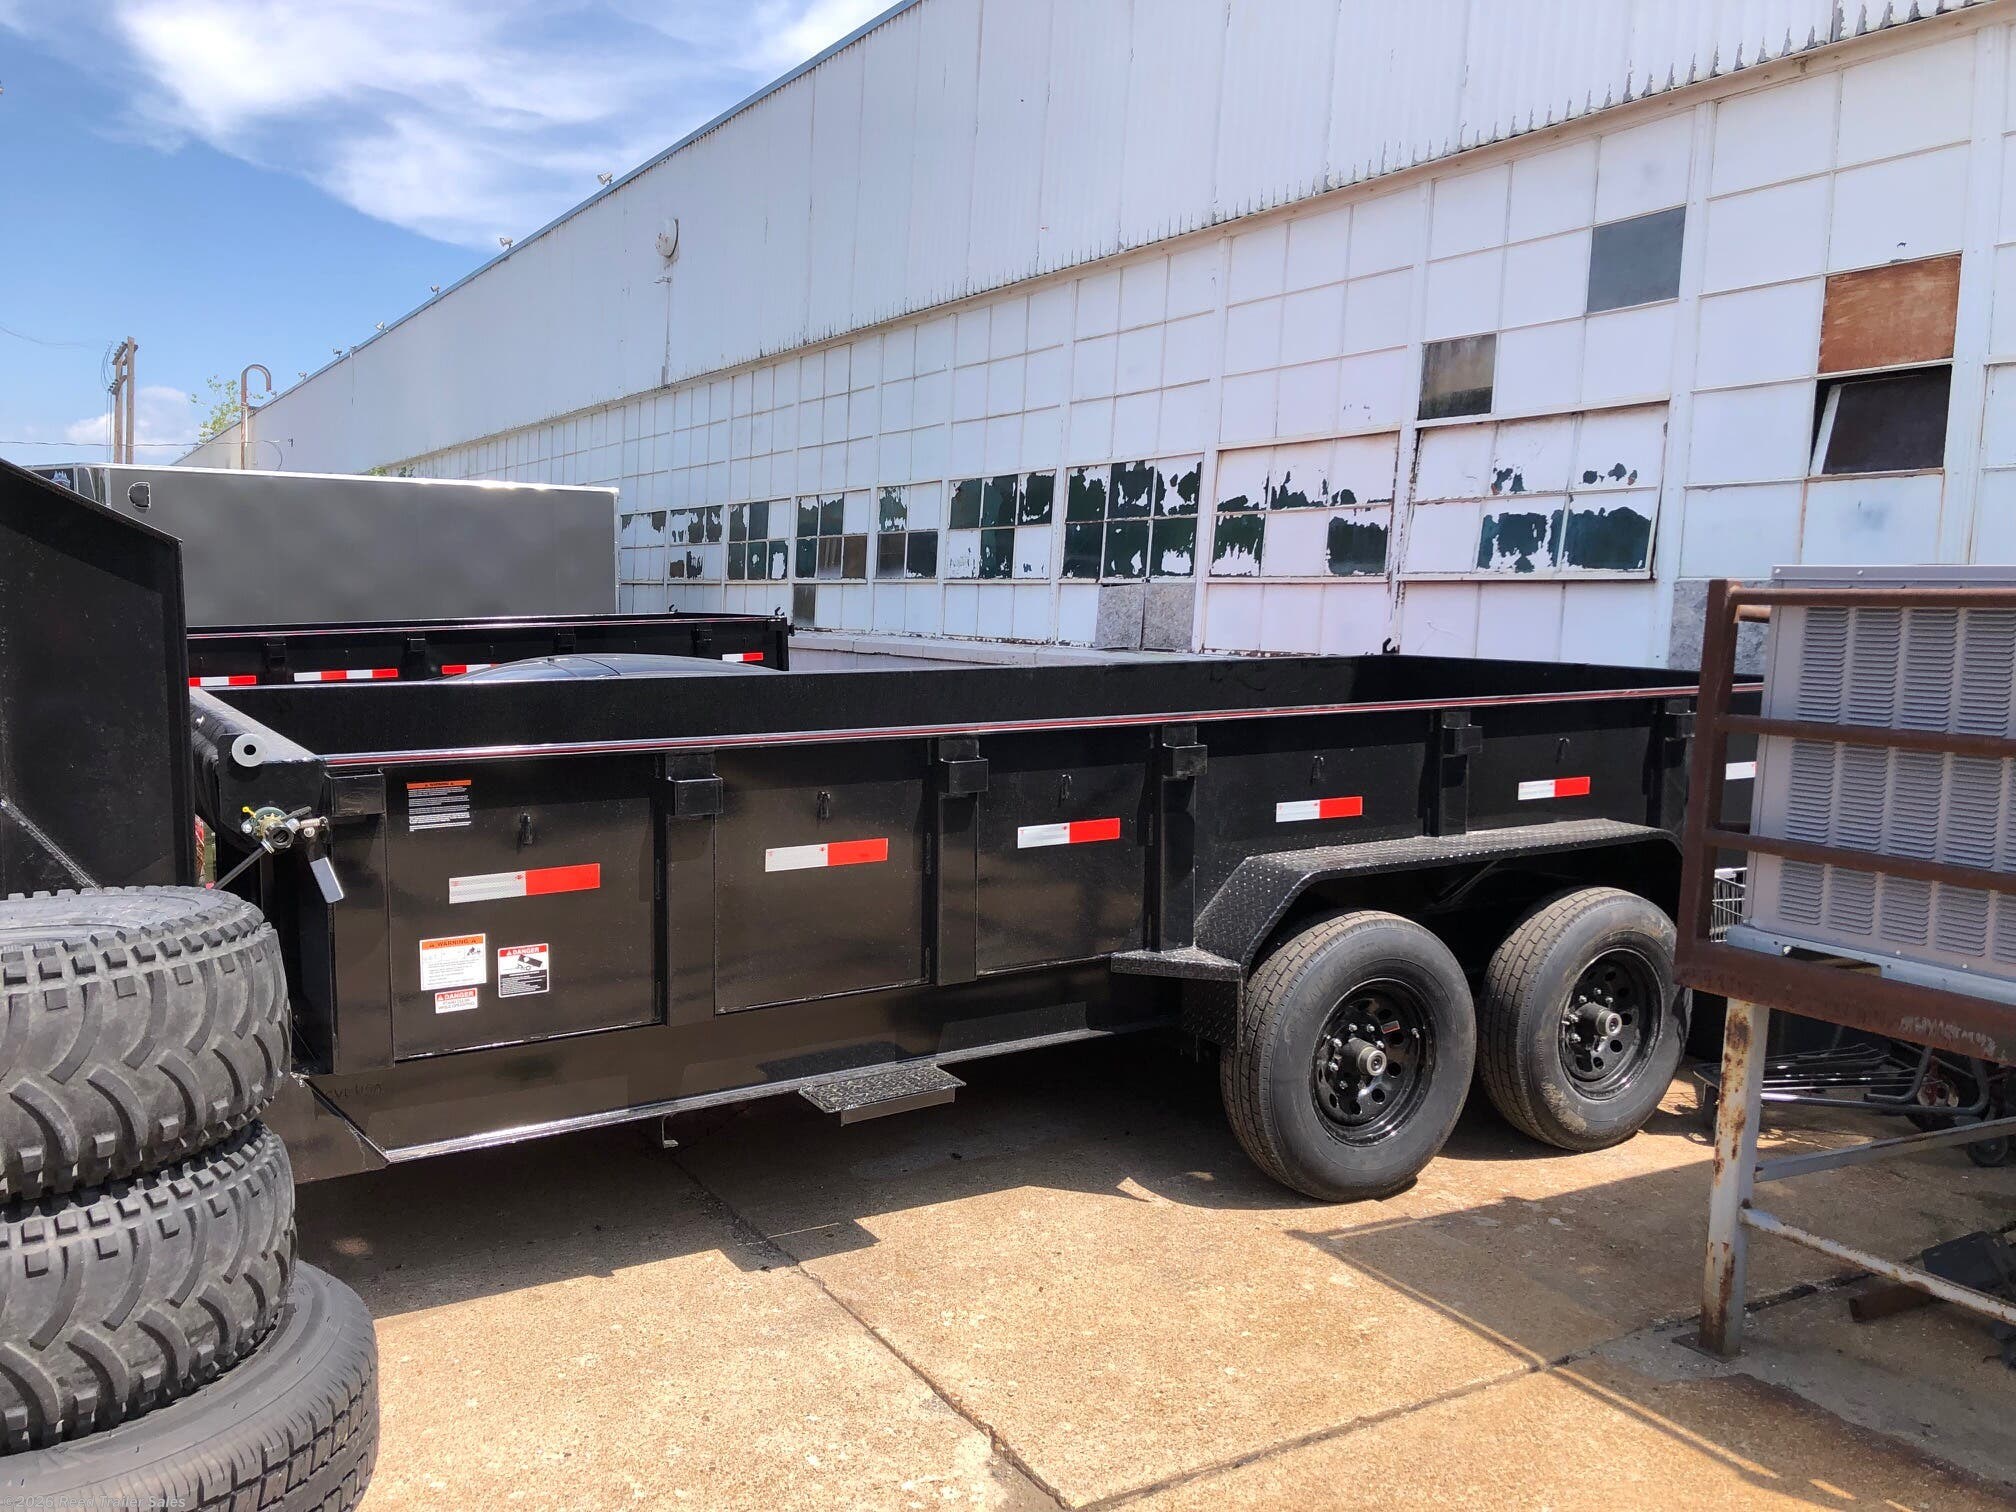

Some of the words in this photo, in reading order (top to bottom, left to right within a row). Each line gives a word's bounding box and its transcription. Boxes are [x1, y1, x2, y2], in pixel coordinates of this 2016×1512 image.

[437, 938, 469, 948] WARNING
[512, 946, 540, 956] DANGER
[444, 990, 475, 1000] DANGER
